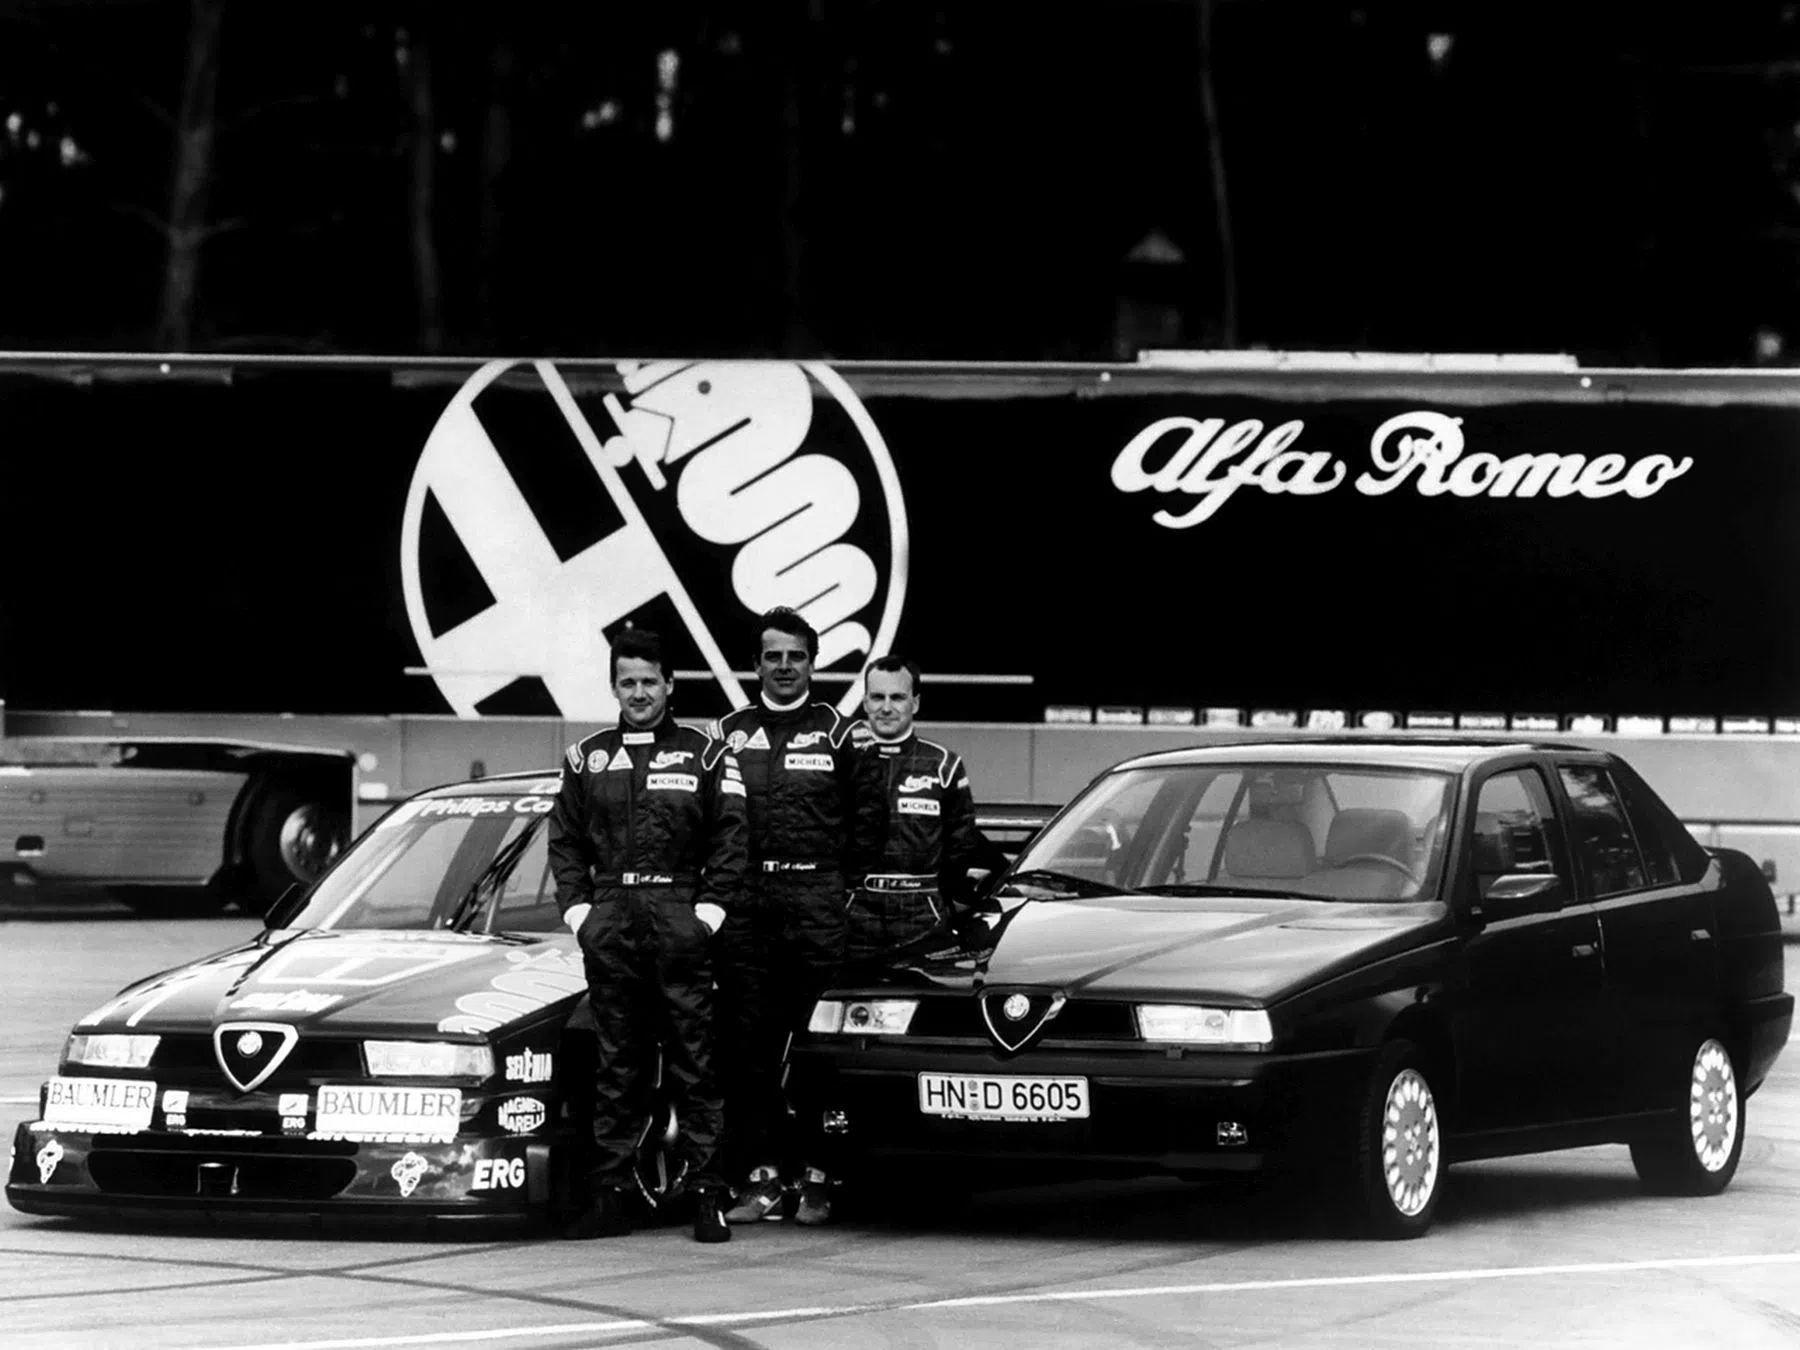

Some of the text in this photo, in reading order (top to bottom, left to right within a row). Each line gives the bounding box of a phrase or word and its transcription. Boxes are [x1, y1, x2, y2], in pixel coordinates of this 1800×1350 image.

[1111, 410, 1694, 529] Alfa Romeo
[788, 757, 832, 767] MICHELIN
[650, 778, 695, 788] MICHELIN
[420, 797, 510, 817] Philips
[1012, 1082, 1081, 1111] 6605
[472, 1158, 526, 1190] ERG
